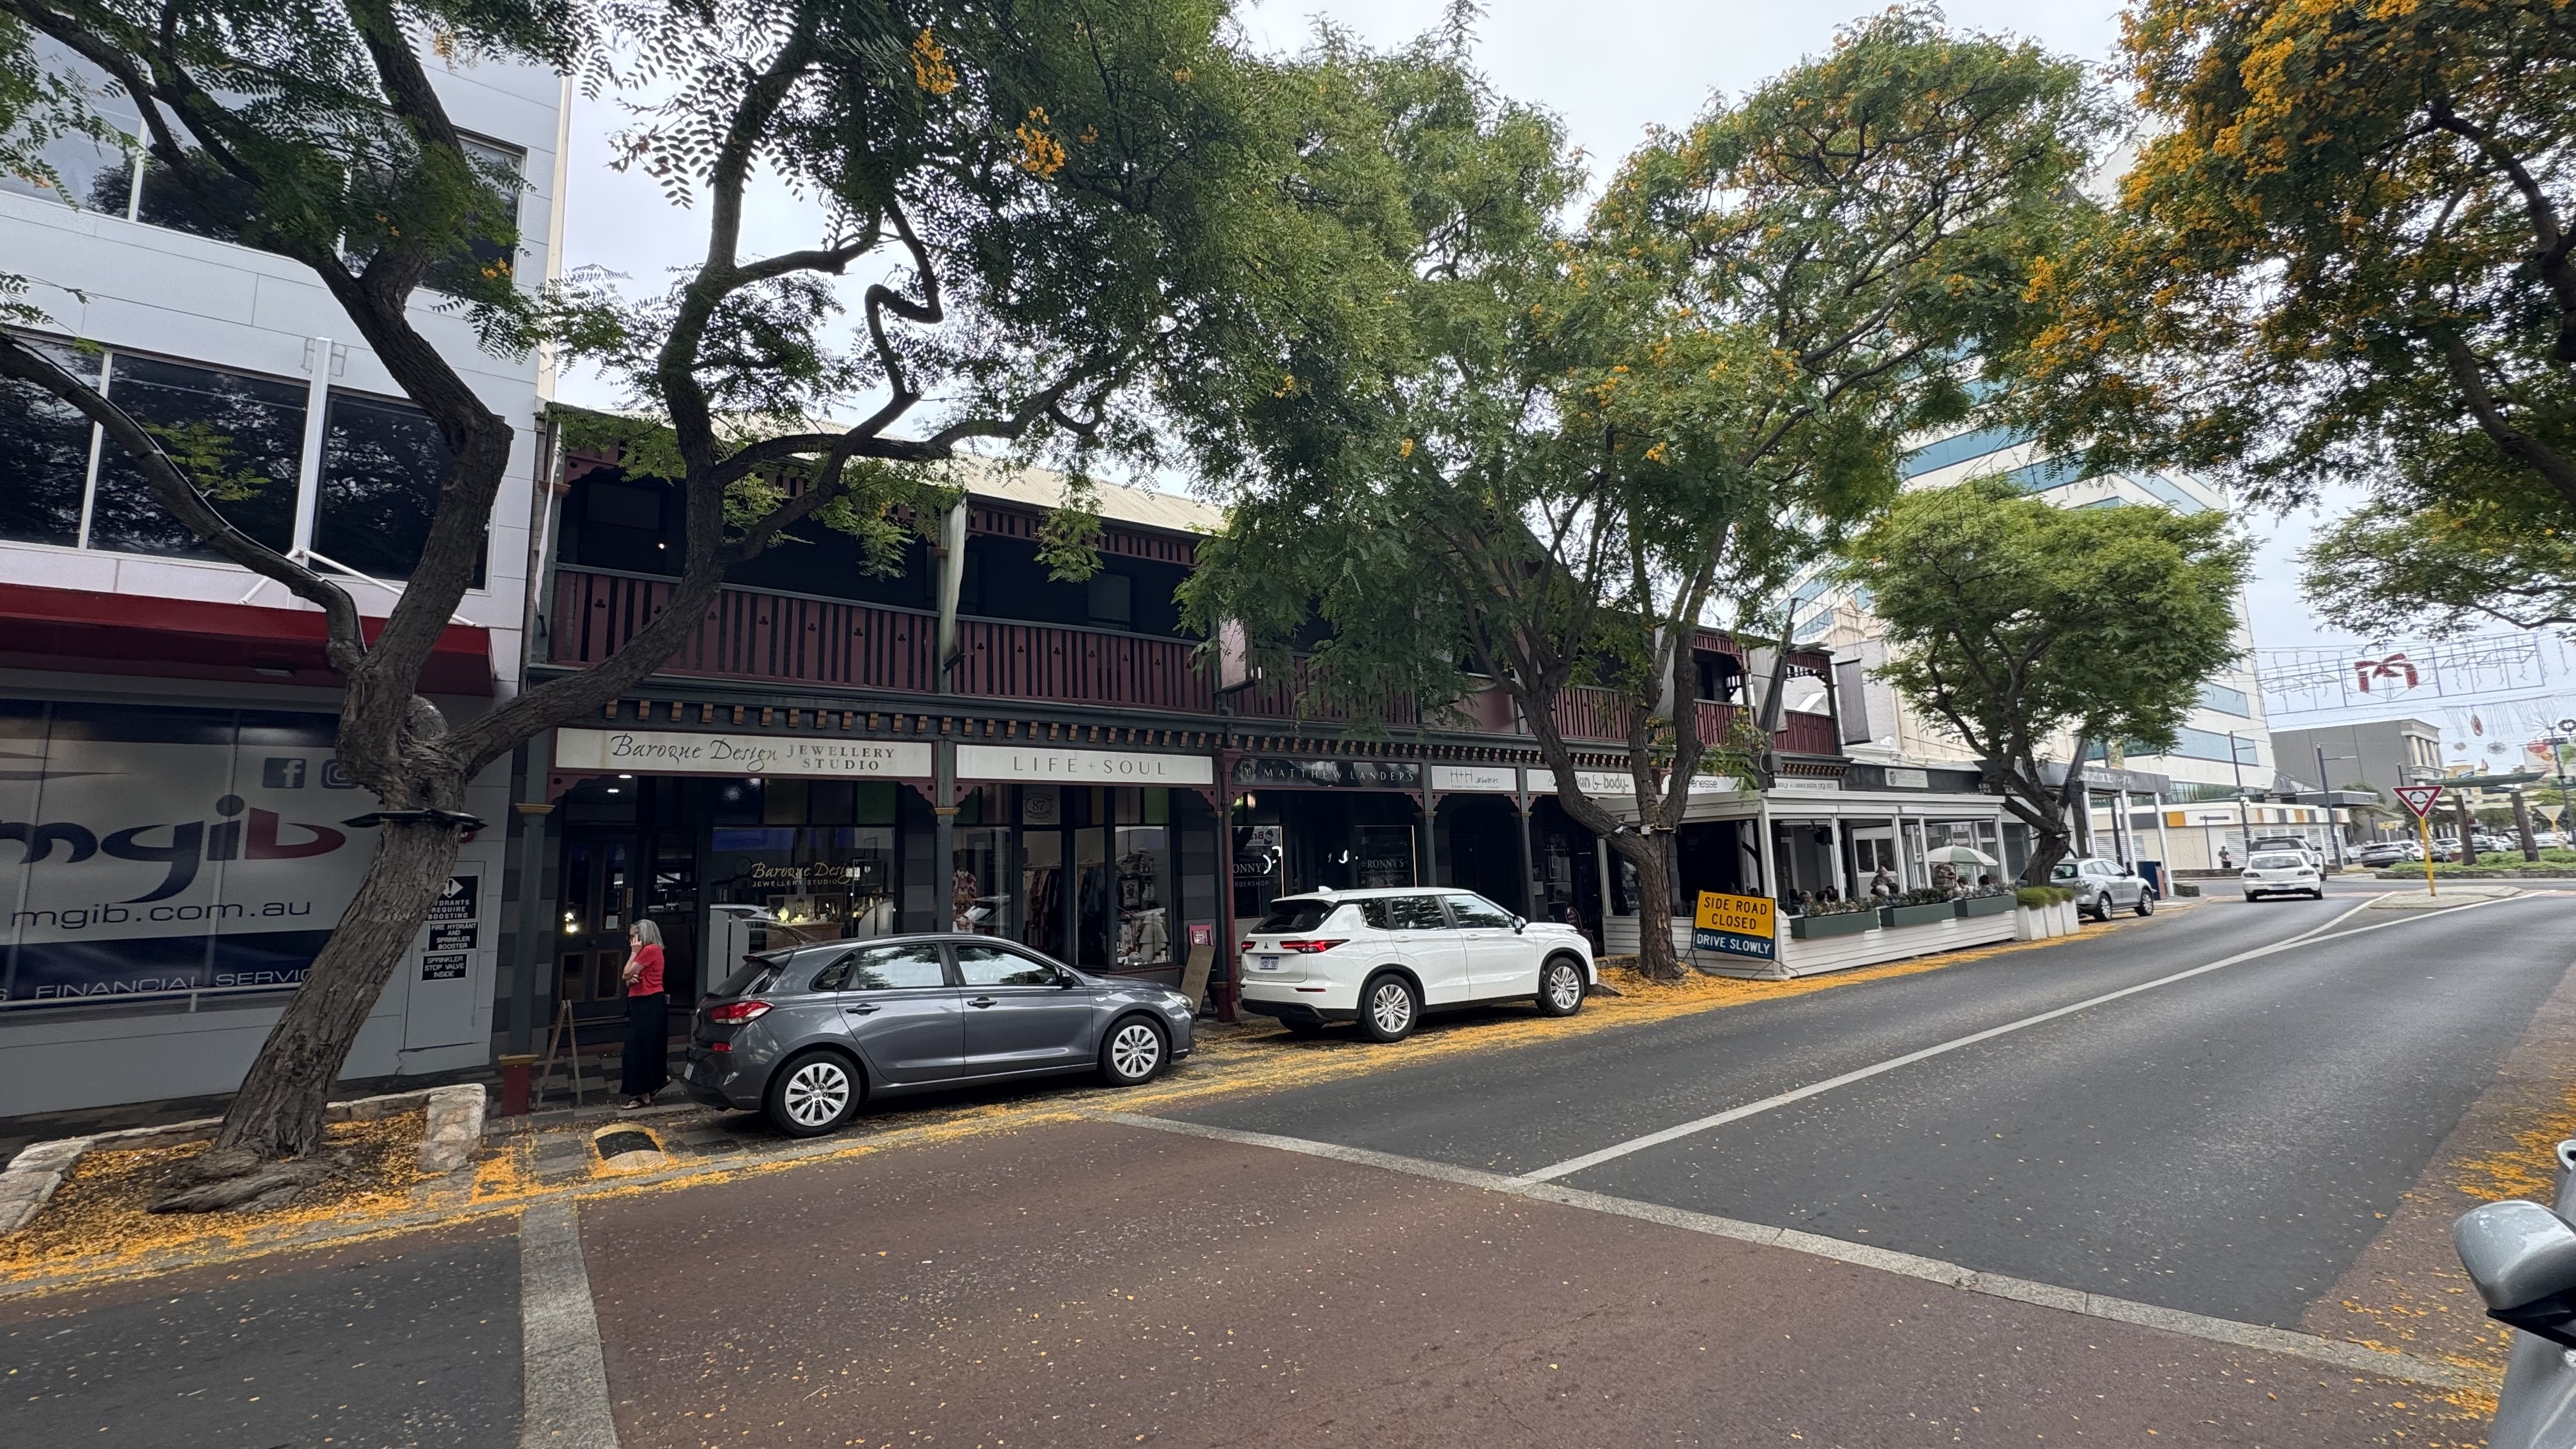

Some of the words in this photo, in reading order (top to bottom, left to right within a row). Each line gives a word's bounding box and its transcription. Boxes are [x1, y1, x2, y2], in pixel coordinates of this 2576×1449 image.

[610, 733, 703, 766] Baroque
[710, 738, 778, 772] Design
[786, 744, 896, 759] JEWELLERY
[802, 758, 879, 771] STUDIO
[1014, 756, 1077, 772] LIFE
[1264, 768, 1343, 779] MATTHEW
[1349, 769, 1414, 781] LANDERS
[1576, 774, 1591, 788] kin
[1032, 800, 1046, 811] 87
[0, 794, 346, 904] mgib
[1233, 862, 1269, 873] ONNY'S
[1367, 858, 1404, 869] RONNY'S
[1704, 896, 1729, 910] SIDE
[1736, 900, 1767, 915] ROAD
[12, 901, 311, 930] mgib.com.au
[1712, 913, 1756, 930] CLOSED
[1697, 933, 1726, 948] DRIVE
[1729, 939, 1770, 954] SLOWLY
[426, 956, 464, 964] SPRINKLER
[36, 977, 203, 999] FINANCIAL
